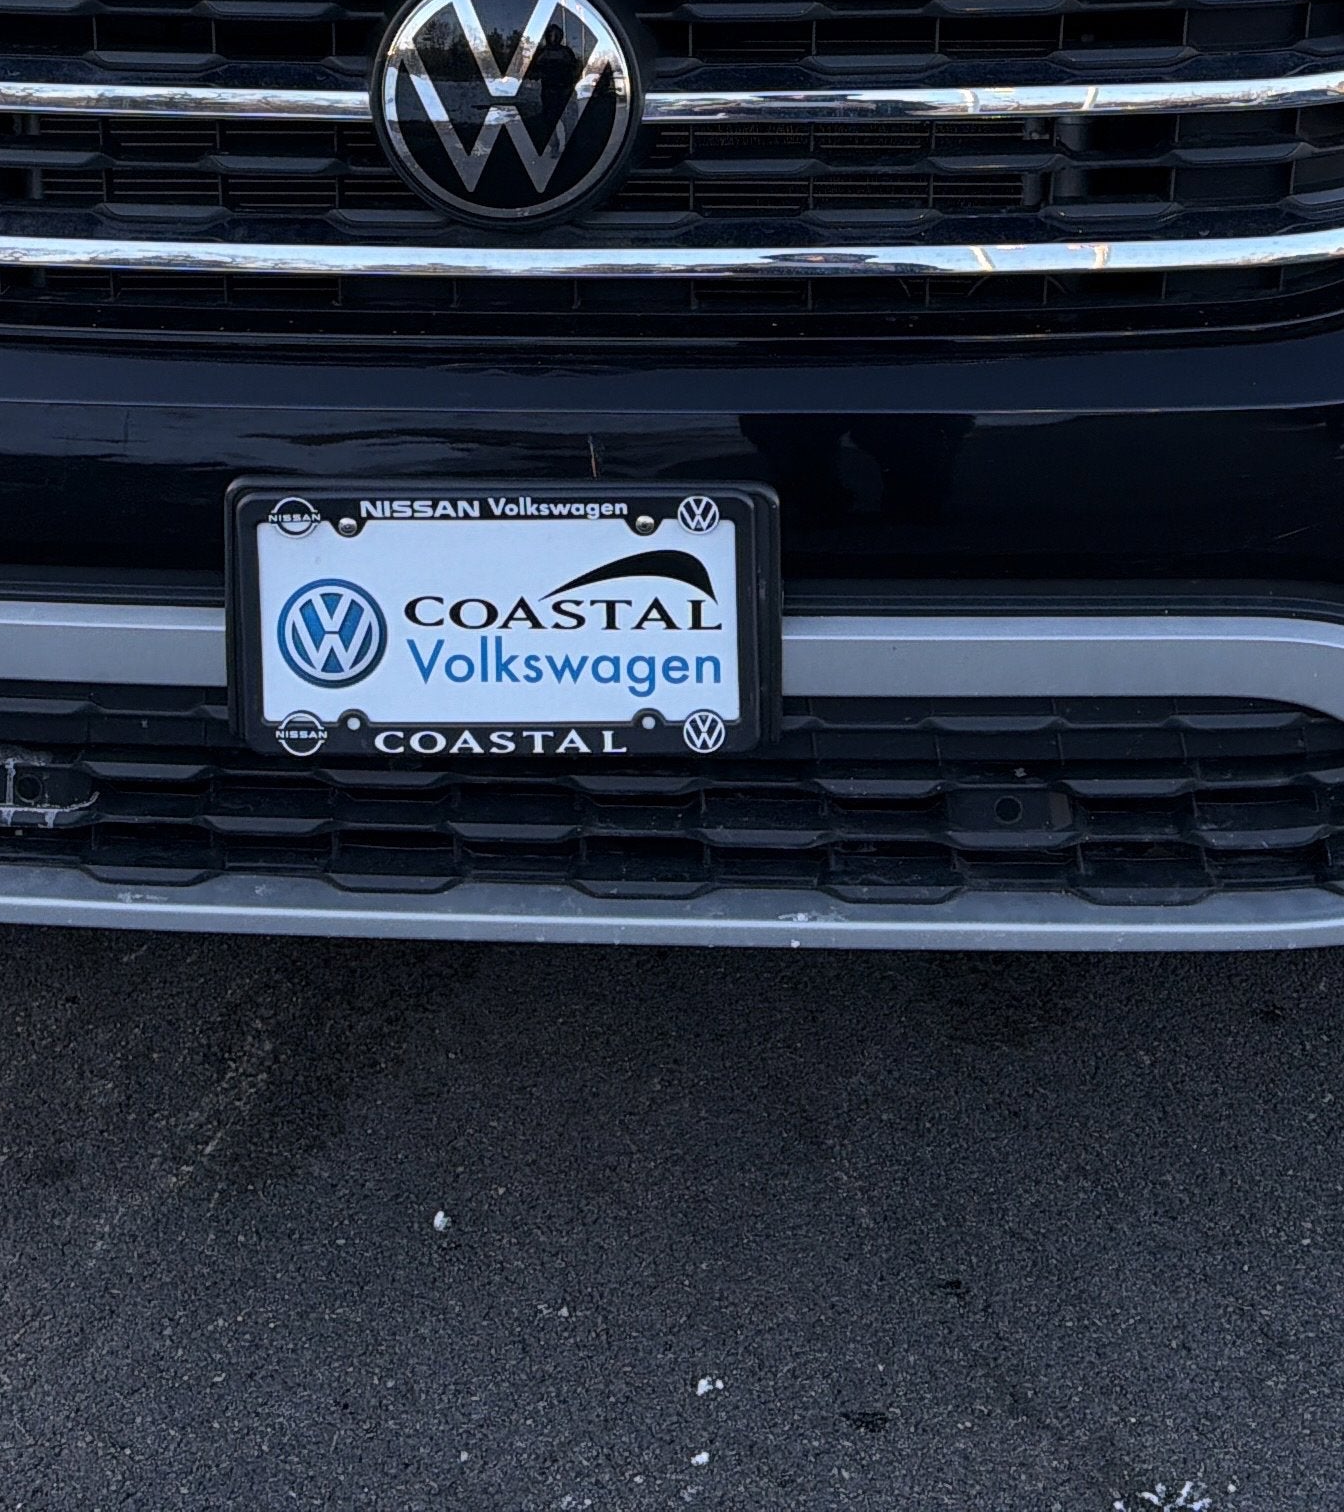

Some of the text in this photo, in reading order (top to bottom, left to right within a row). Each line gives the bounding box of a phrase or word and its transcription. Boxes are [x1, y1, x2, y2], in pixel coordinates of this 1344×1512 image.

[268, 513, 321, 522] NISSAN
[360, 497, 628, 520] NISSAN Volkswagen
[404, 595, 723, 631] COASTAL
[406, 635, 722, 698] Volkswagen
[275, 729, 328, 740] NISSAN
[374, 729, 627, 754] COASTAL
